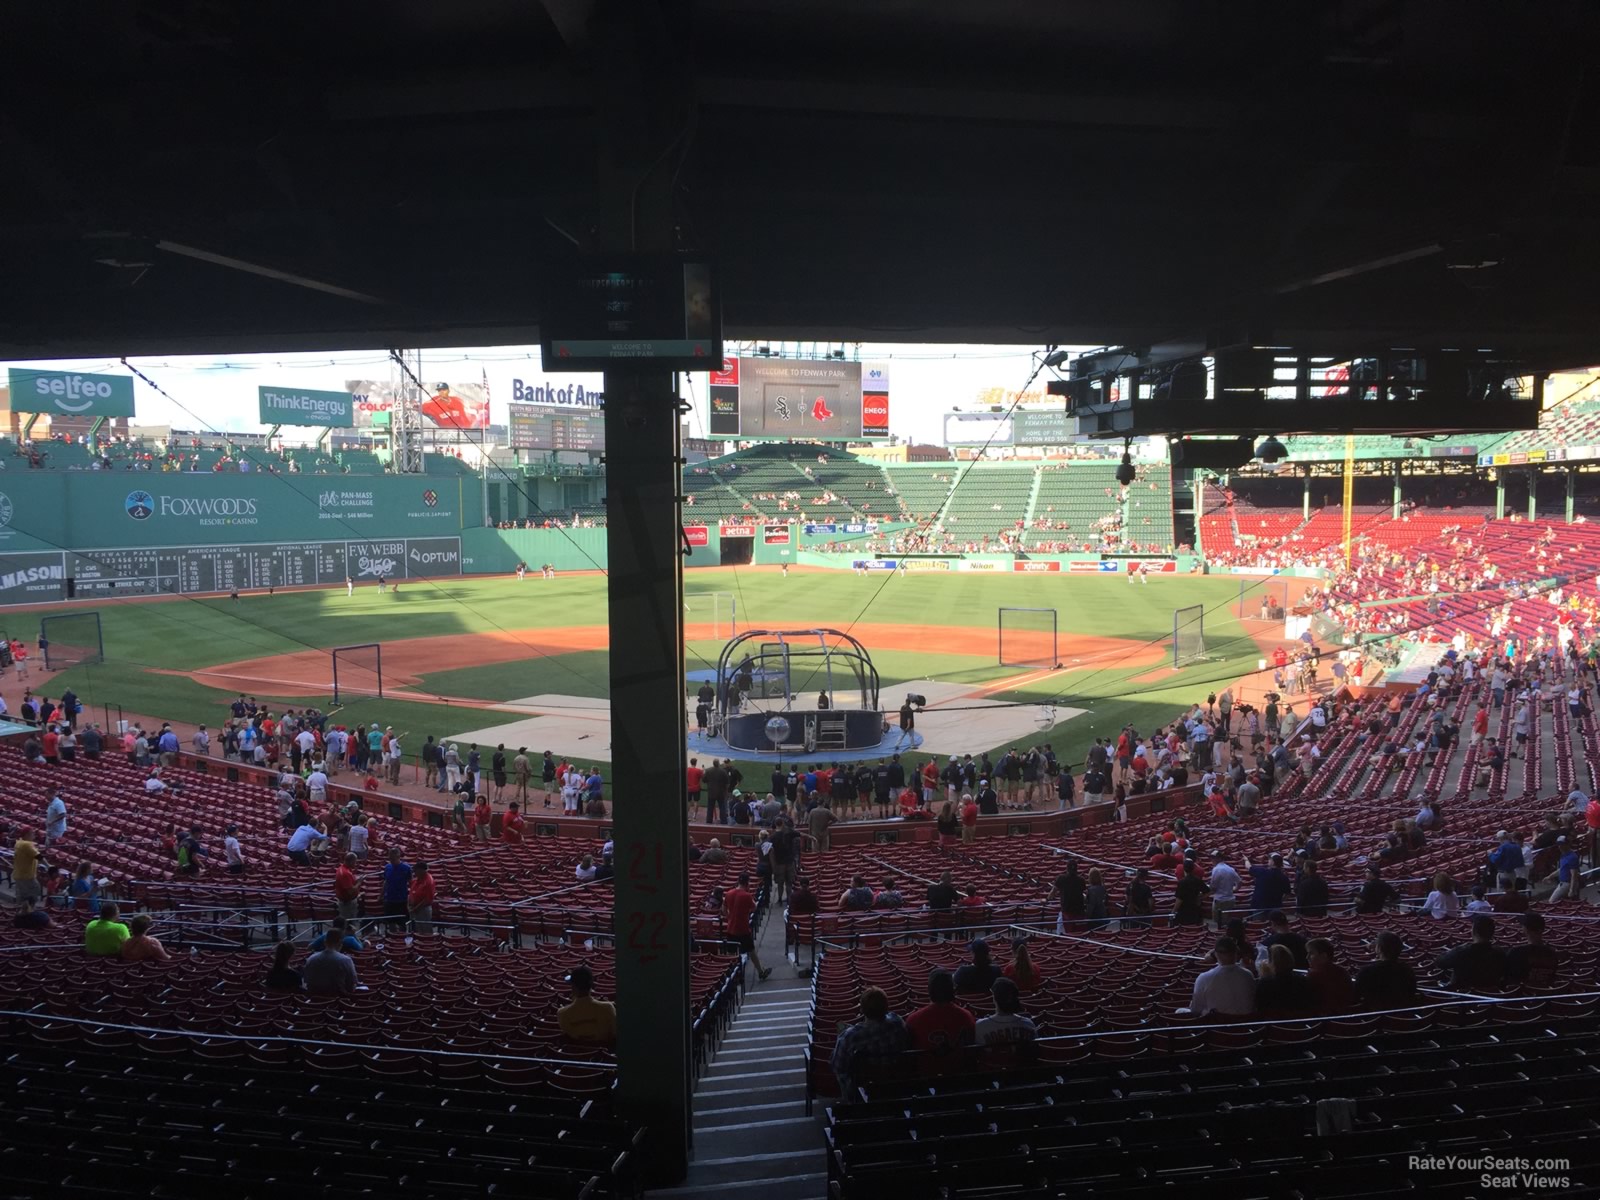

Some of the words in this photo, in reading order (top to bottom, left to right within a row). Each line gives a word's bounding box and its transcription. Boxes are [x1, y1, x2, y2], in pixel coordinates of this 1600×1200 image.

[755, 368, 788, 376] WELCOME
[801, 369, 827, 377] FENWAY
[513, 379, 555, 403] Bank
[557, 384, 574, 404] of
[264, 393, 346, 415] ThinkEnergy
[160, 496, 257, 516] FOXWOODS
[725, 527, 750, 535] aetna
[349, 545, 369, 556] F.W.
[371, 544, 404, 555] WEBB
[422, 552, 457, 563] OPTUM
[1023, 562, 1050, 571] xfinity
[628, 841, 663, 880] 21
[628, 911, 669, 949] 22
